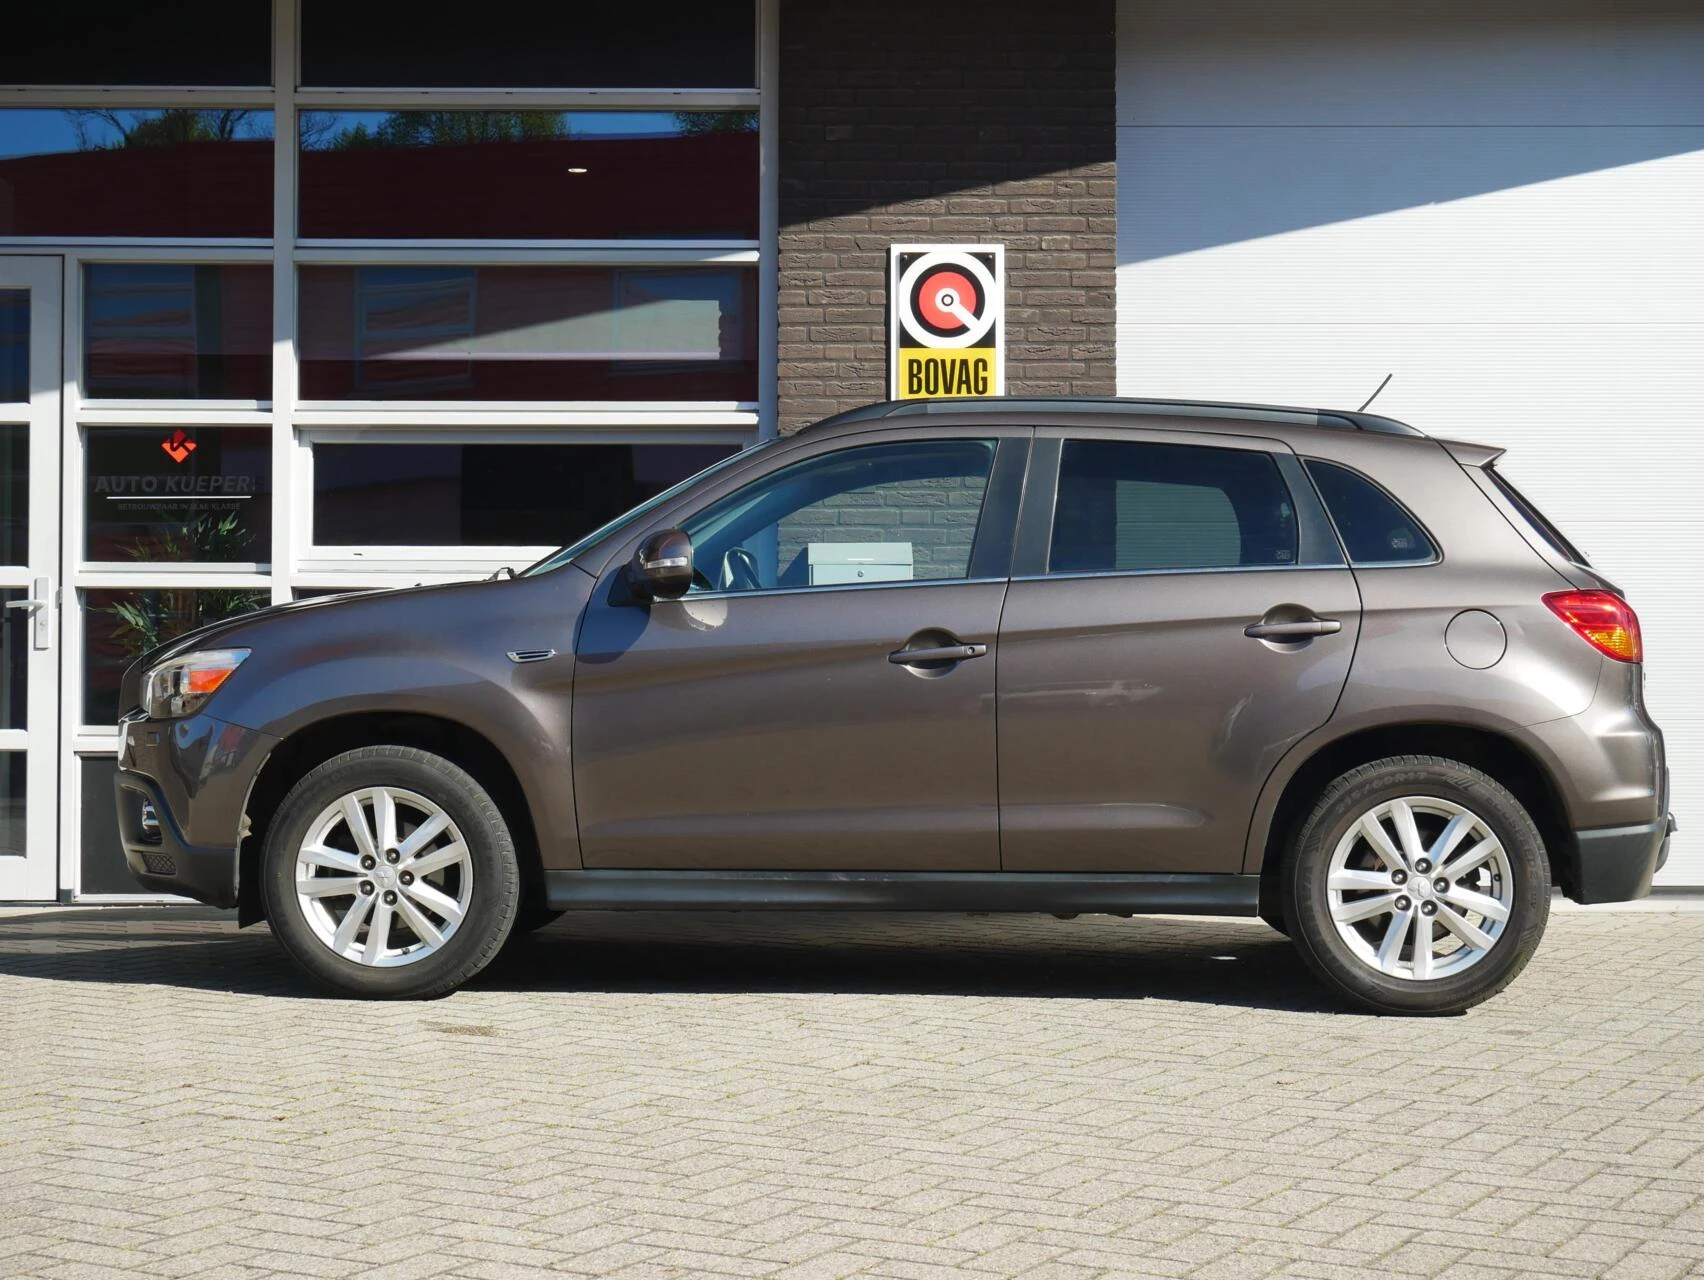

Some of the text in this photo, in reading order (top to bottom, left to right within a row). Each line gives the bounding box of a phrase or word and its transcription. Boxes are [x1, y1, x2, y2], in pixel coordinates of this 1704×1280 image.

[908, 358, 988, 395] BOVAG
[95, 475, 250, 493] AUTO KUEPER
